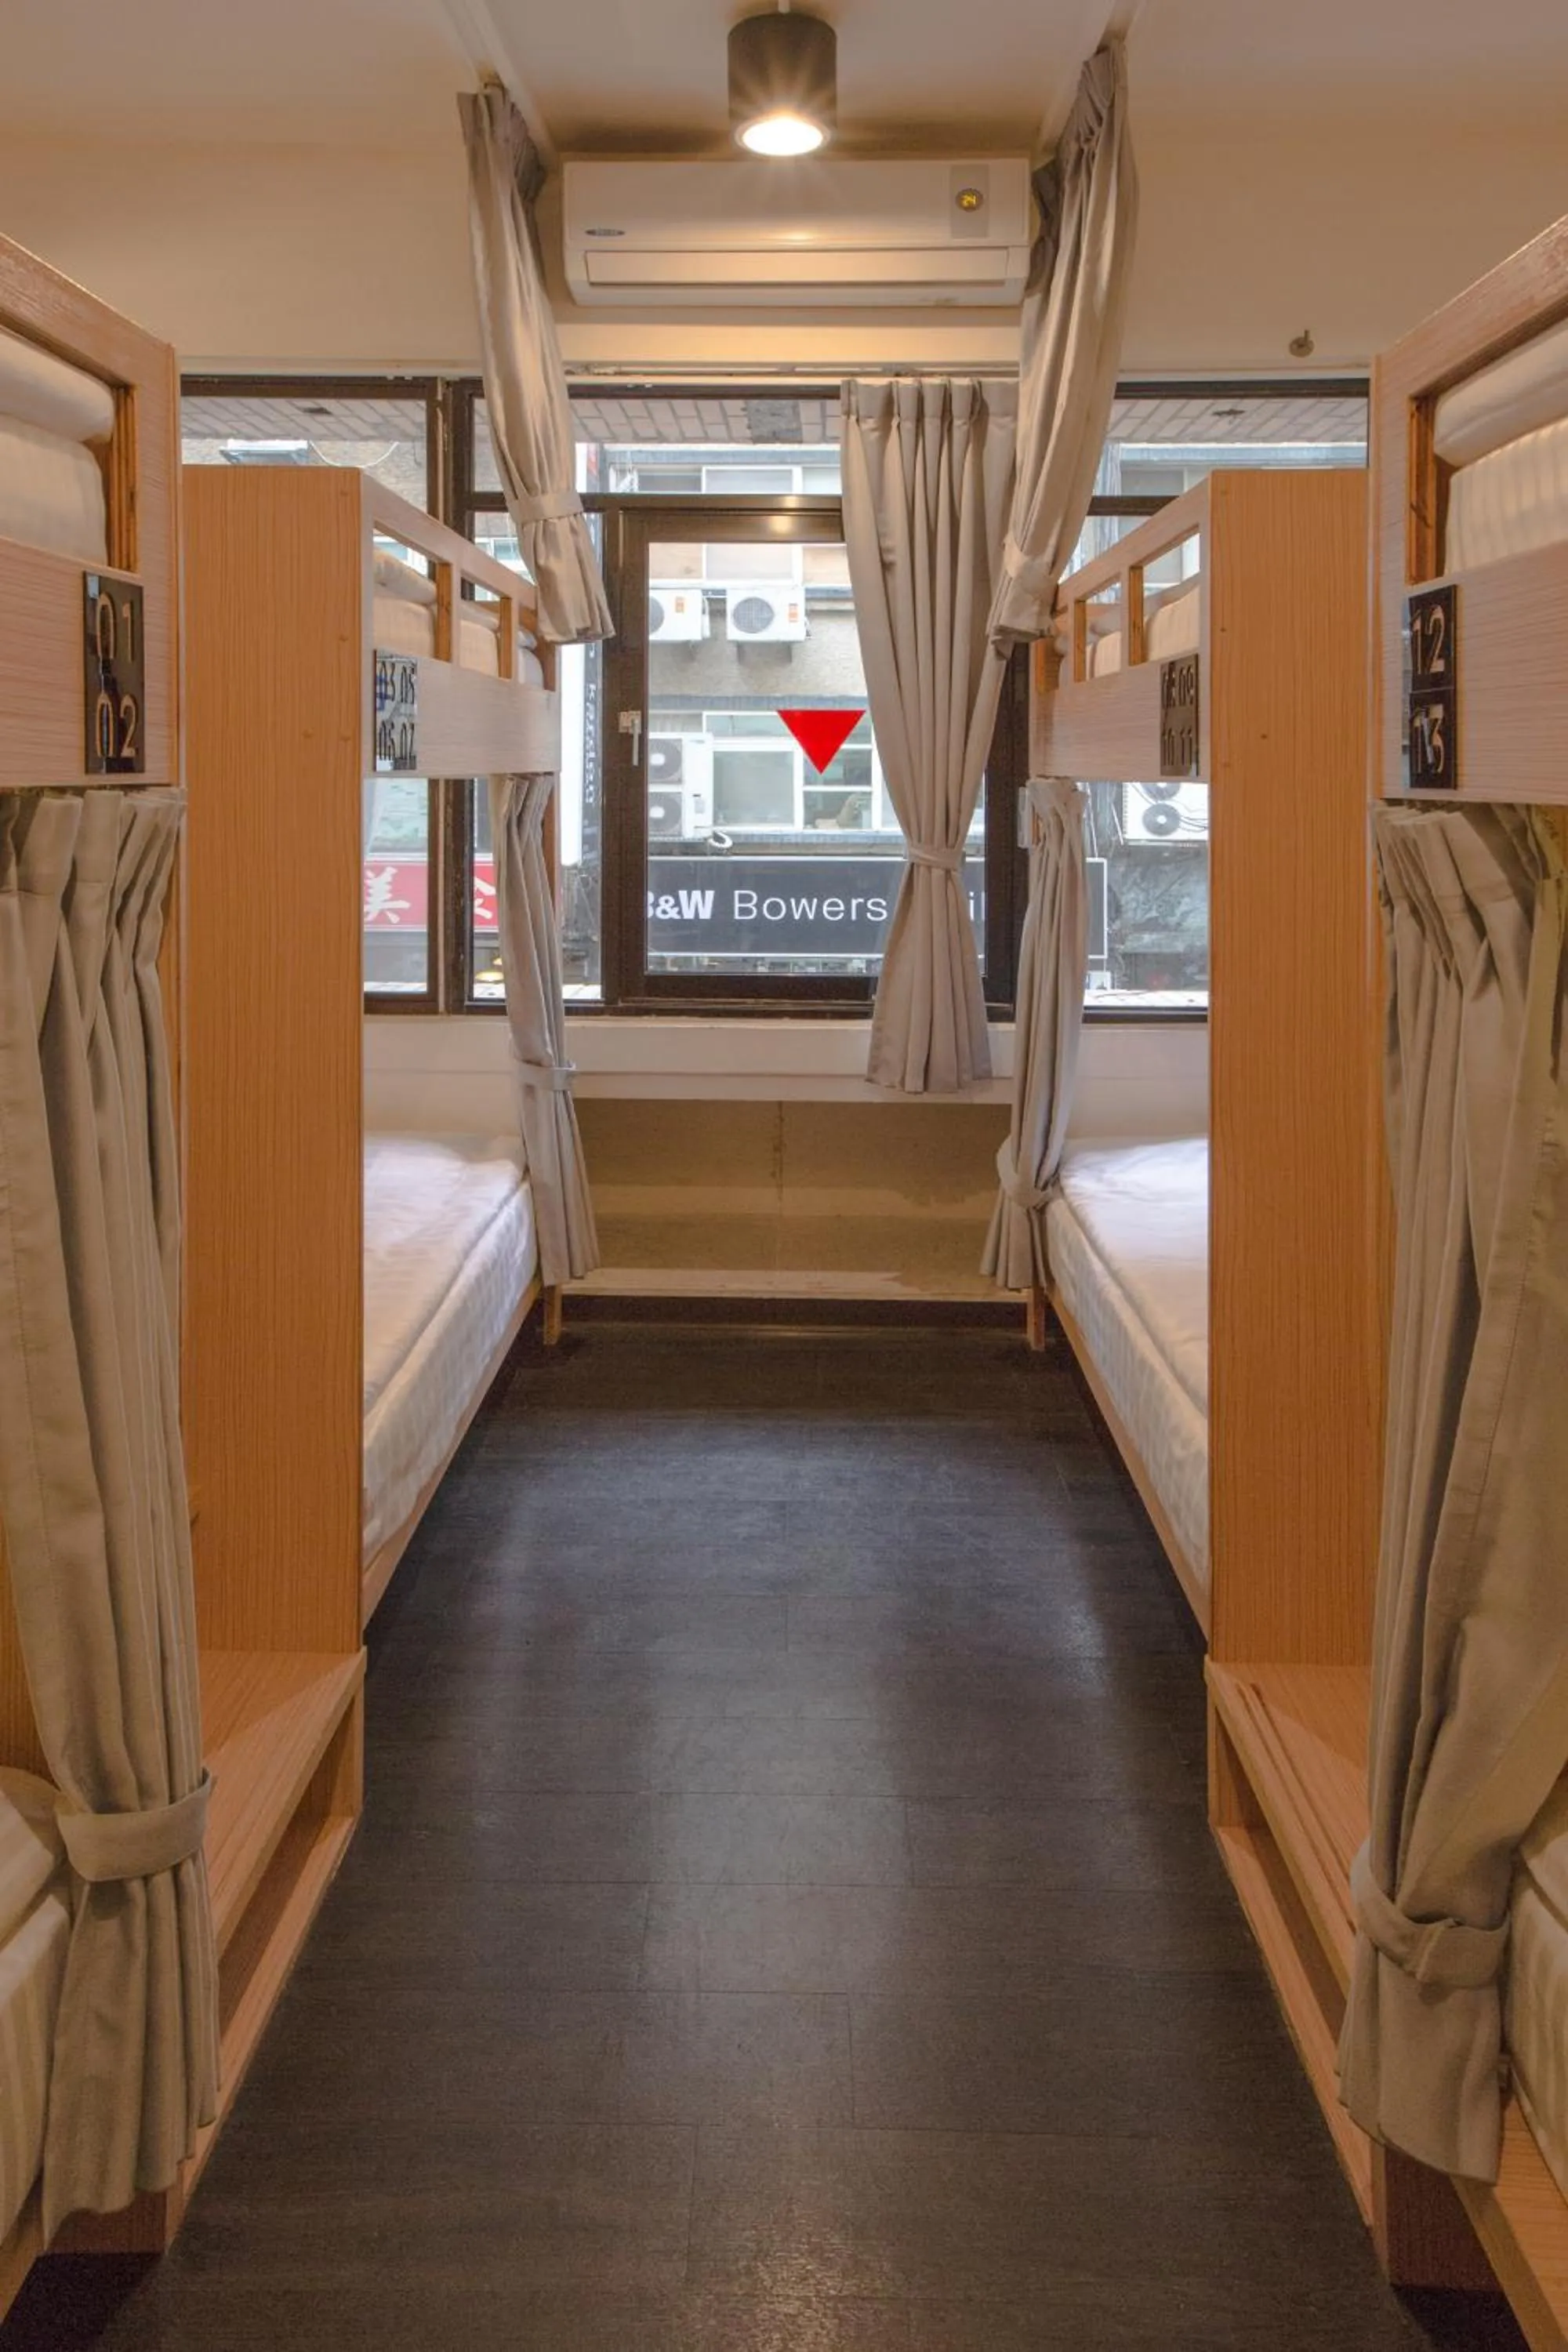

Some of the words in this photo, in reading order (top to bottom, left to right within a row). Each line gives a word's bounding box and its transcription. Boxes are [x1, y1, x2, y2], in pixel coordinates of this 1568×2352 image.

[95, 591, 135, 663] 01
[1409, 604, 1446, 676] 12
[95, 693, 138, 758] 02
[734, 890, 888, 921] Bowers
